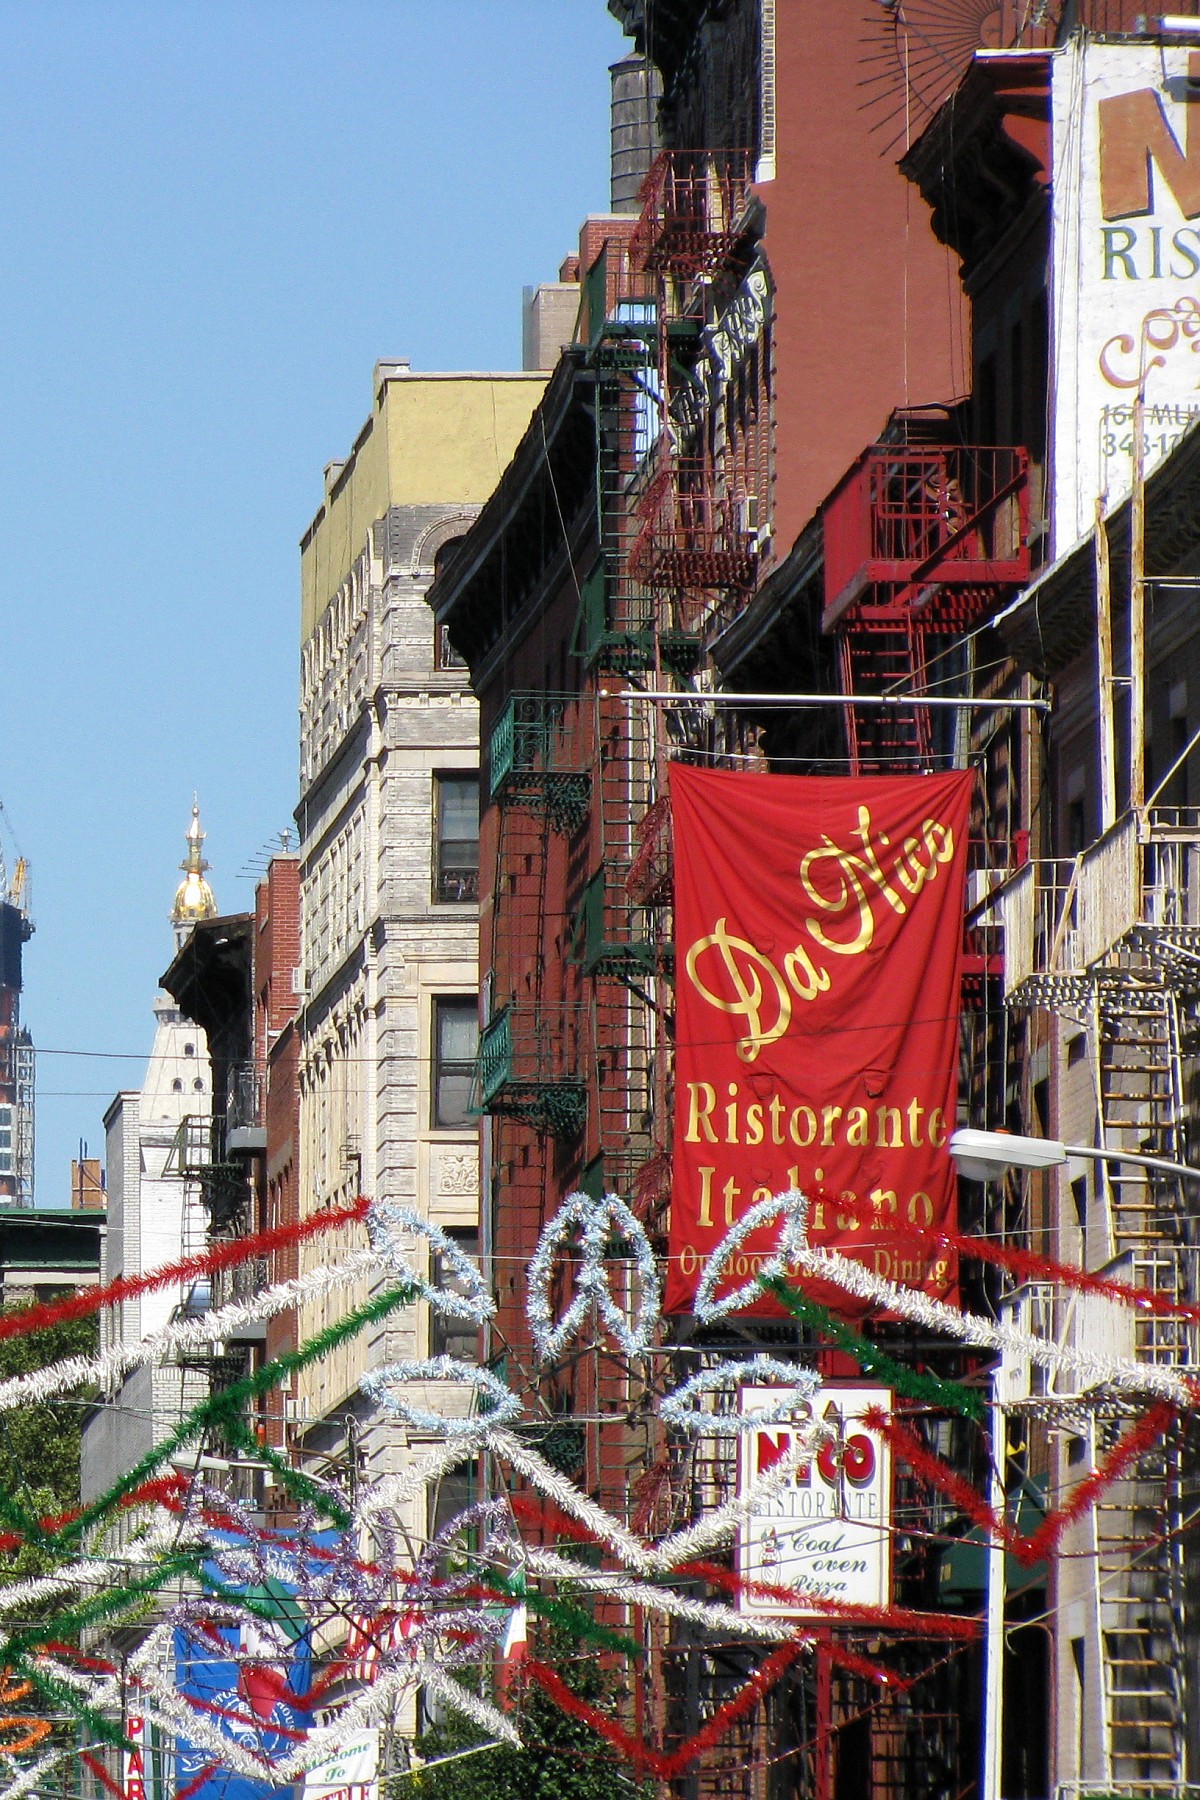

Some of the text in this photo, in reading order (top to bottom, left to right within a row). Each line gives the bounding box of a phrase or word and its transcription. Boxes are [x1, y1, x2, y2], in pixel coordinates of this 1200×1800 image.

[1100, 226, 1200, 281] RIS
[1101, 403, 1144, 426] 16
[800, 805, 954, 954] Nico
[686, 917, 831, 1062] Da
[684, 1082, 947, 1148] Ristorante
[753, 1491, 878, 1518] ISTORANTE
[792, 1533, 845, 1551] Coal
[812, 1560, 868, 1573] oven
[790, 1575, 848, 1596] Pizza
[305, 1742, 372, 1770] elcome
